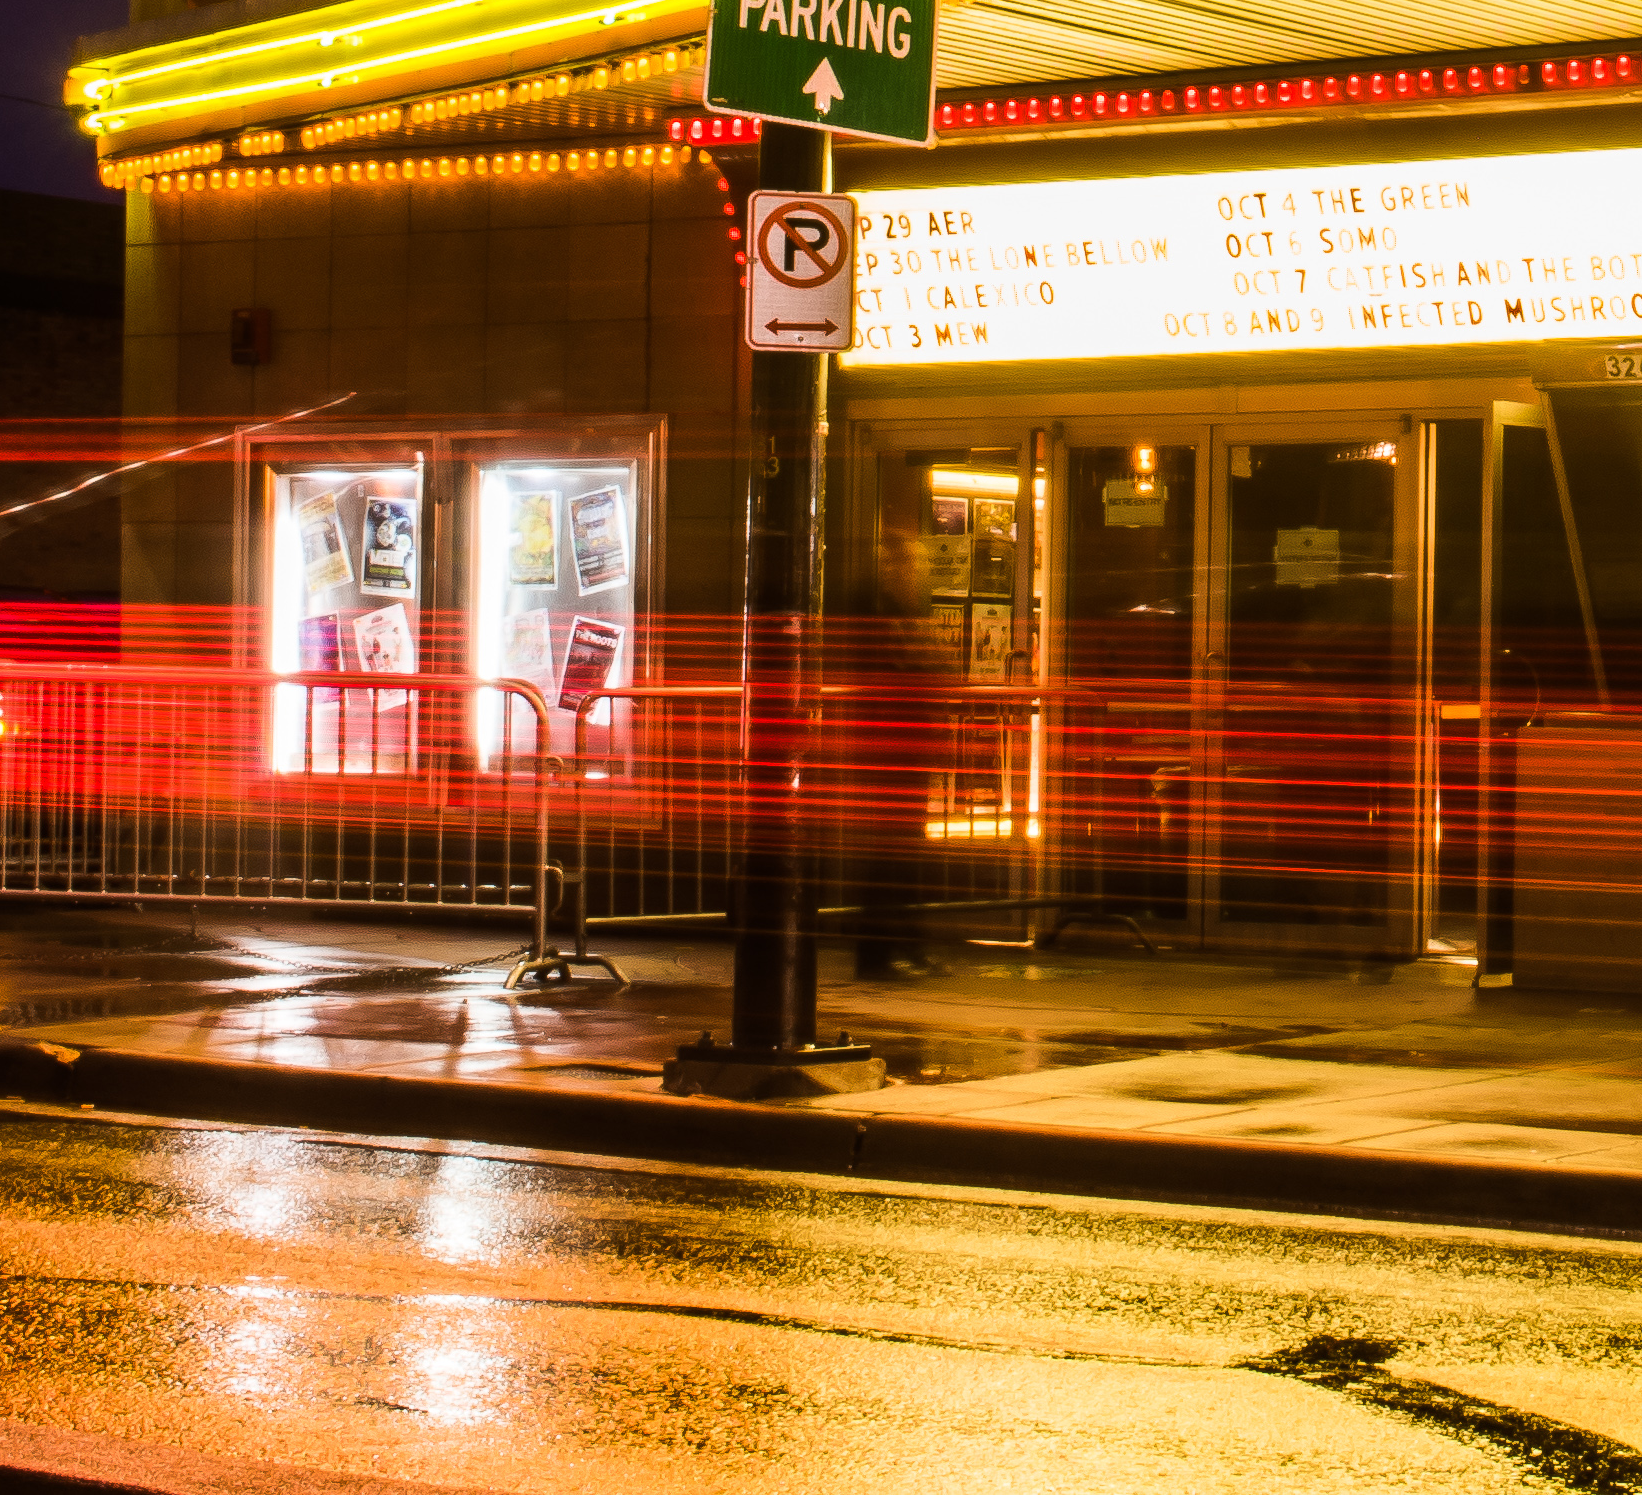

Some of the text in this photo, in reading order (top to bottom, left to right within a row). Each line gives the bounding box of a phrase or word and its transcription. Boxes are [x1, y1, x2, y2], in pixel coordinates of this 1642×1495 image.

[1217, 181, 1472, 221] OCT 4 THE GREEN
[882, 213, 912, 239] 29
[927, 210, 976, 237] AER
[890, 250, 923, 275] 30
[929, 246, 981, 273] THE
[987, 243, 1057, 272] LONE
[1064, 237, 1170, 267] BELLOW
[1225, 226, 1398, 259] OCT 6 SOMO
[1233, 269, 1282, 296] OCT
[1293, 268, 1306, 294] 7
[1326, 262, 1447, 293] CATFISH
[1457, 260, 1511, 286] AND
[1521, 256, 1577, 283] THE
[926, 280, 1055, 310] CALEXICO
[908, 323, 923, 348] 3
[934, 320, 990, 347] MEW
[1164, 311, 1210, 337] OCT
[1223, 310, 1238, 336] 8
[1249, 307, 1302, 334] AND
[1310, 307, 1325, 332] 9
[1347, 299, 1484, 331] INFECTED
